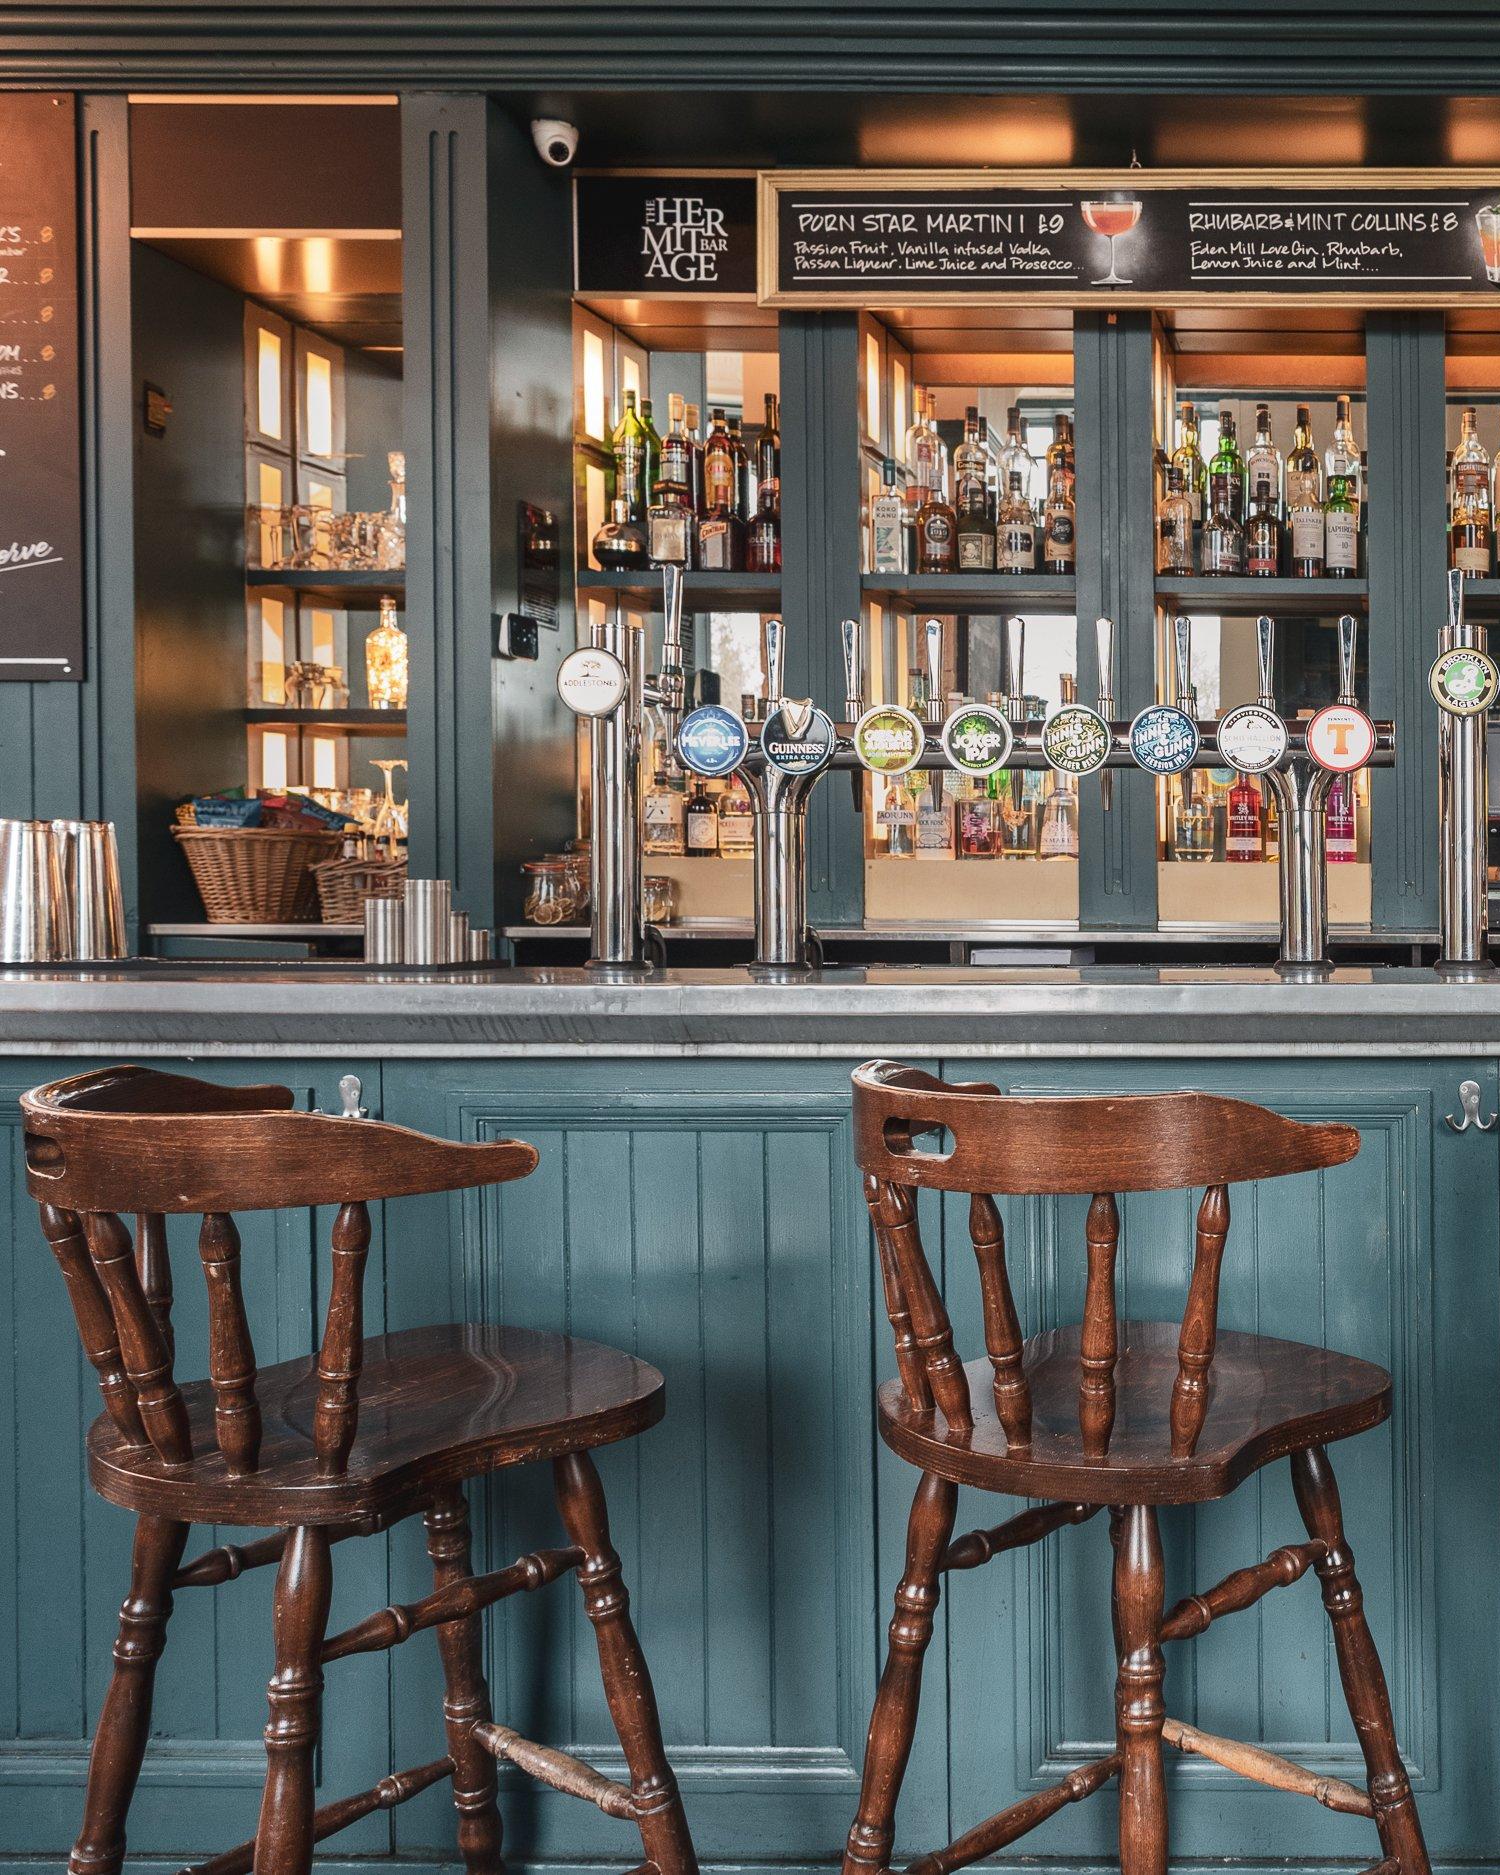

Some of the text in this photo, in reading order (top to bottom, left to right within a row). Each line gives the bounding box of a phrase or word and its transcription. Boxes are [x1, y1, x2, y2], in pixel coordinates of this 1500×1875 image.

[798, 213, 855, 233] PORN
[862, 213, 919, 233] STAR
[1037, 214, 1066, 234] £9
[1296, 213, 1348, 231] MINT
[1351, 212, 1428, 232] COLLINS
[700, 238, 729, 252] BAR
[793, 241, 847, 256] Passion
[897, 241, 949, 256] Vanilla
[953, 240, 1003, 255] infused
[1190, 240, 1228, 256] Eden
[1229, 240, 1256, 256] Mill
[1260, 240, 1289, 255] Love
[793, 256, 840, 272] Passoa
[904, 256, 937, 271] Lime
[938, 256, 978, 271] Juice
[980, 256, 1007, 271] and
[1191, 256, 1241, 271] Lemon
[1242, 256, 1284, 270] Juice
[1287, 256, 1317, 270] and
[1441, 653, 1490, 674] BROOKLYN
[563, 679, 618, 688] ADDLESTONES
[1445, 694, 1481, 708] LAGER
[951, 731, 1001, 749] JOKER
[1047, 722, 1084, 746] INNIS
[1135, 722, 1171, 746] INNIS
[1326, 723, 1355, 755] T
[768, 742, 826, 755] GUINNESS
[965, 746, 989, 761] IPA
[1066, 735, 1105, 758] GUNN
[1153, 735, 1192, 758] GUNN
